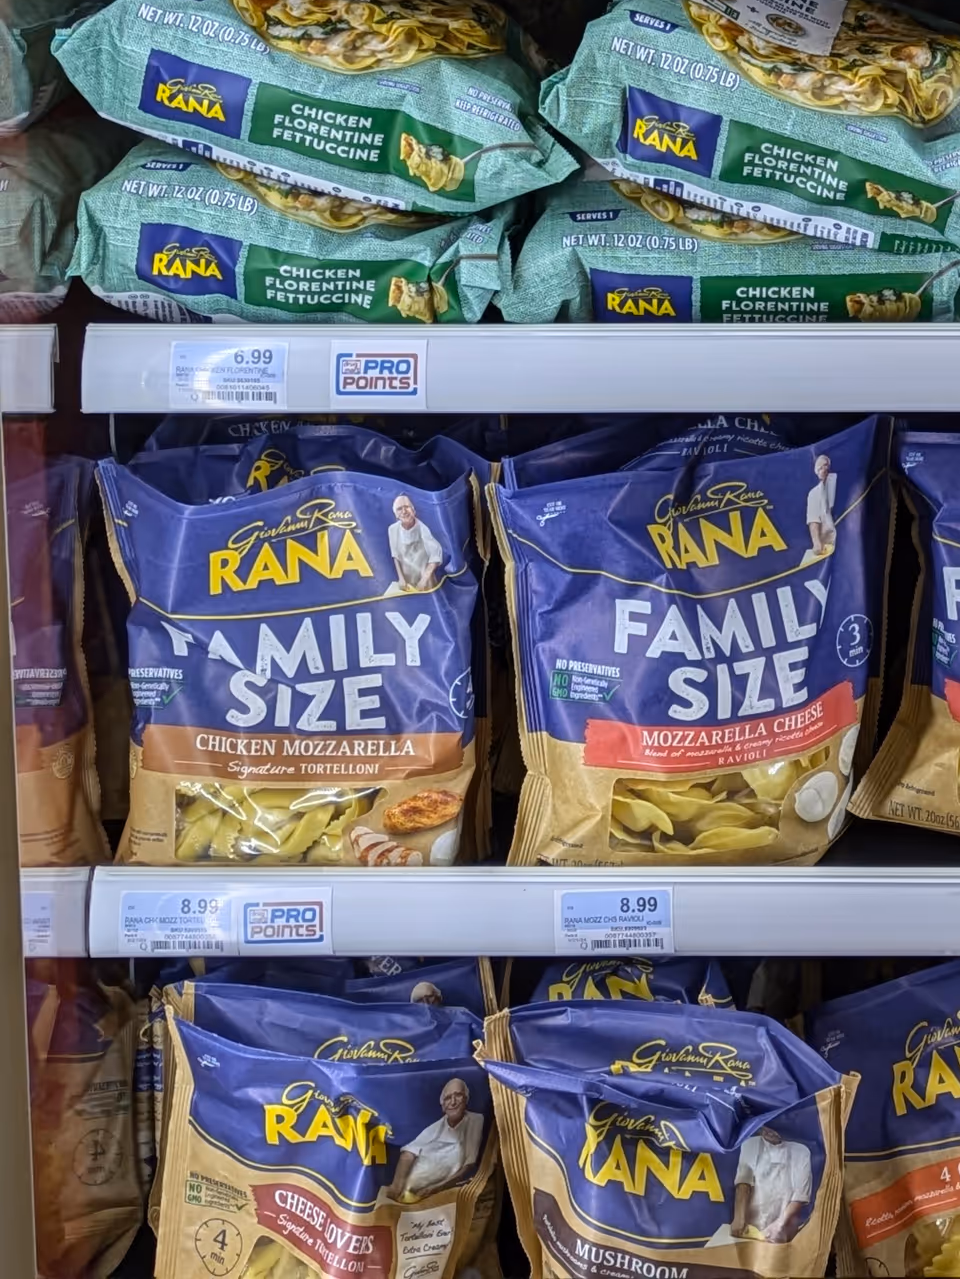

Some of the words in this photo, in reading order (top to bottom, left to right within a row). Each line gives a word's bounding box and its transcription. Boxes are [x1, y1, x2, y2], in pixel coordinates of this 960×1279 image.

[156, 82, 226, 122] RANA
[632, 123, 698, 160] RANA
[562, 234, 582, 247] NET
[586, 234, 611, 248] WT.
[613, 234, 623, 247] 12
[626, 234, 643, 248] OZ
[646, 235, 674, 251] (0.75
[677, 236, 698, 251] LB)
[152, 253, 222, 279] RANA
[279, 266, 361, 279] CHICKEN
[265, 277, 376, 292] FLORENTINE
[266, 289, 373, 308] FETTUCCINE
[233, 349, 273, 364] 6.99
[647, 506, 787, 570] RANA
[210, 529, 373, 596] RANA
[614, 579, 831, 660] FAMILY
[849, 624, 861, 644] 3
[849, 646, 863, 657] min
[556, 659, 567, 670] NO
[569, 660, 620, 677] PRESERVATIVES
[668, 647, 809, 720] SIZE
[225, 670, 387, 732] SIZE
[642, 724, 767, 747] MOZZARELLA
[773, 701, 824, 733] CHEESE
[196, 734, 275, 756] CHICKEN
[282, 739, 415, 756] MOZZARELLA
[227, 761, 295, 778] Signature
[300, 763, 379, 774] TORTELLONI
[181, 899, 219, 914] 8.99
[620, 898, 657, 913] 8.99
[940, 1166, 951, 1182] 4
[275, 1190, 325, 1231] CHEESE
[213, 1229, 227, 1250] 4
[210, 1251, 225, 1265] min
[575, 1239, 688, 1278] MUSHROOM
